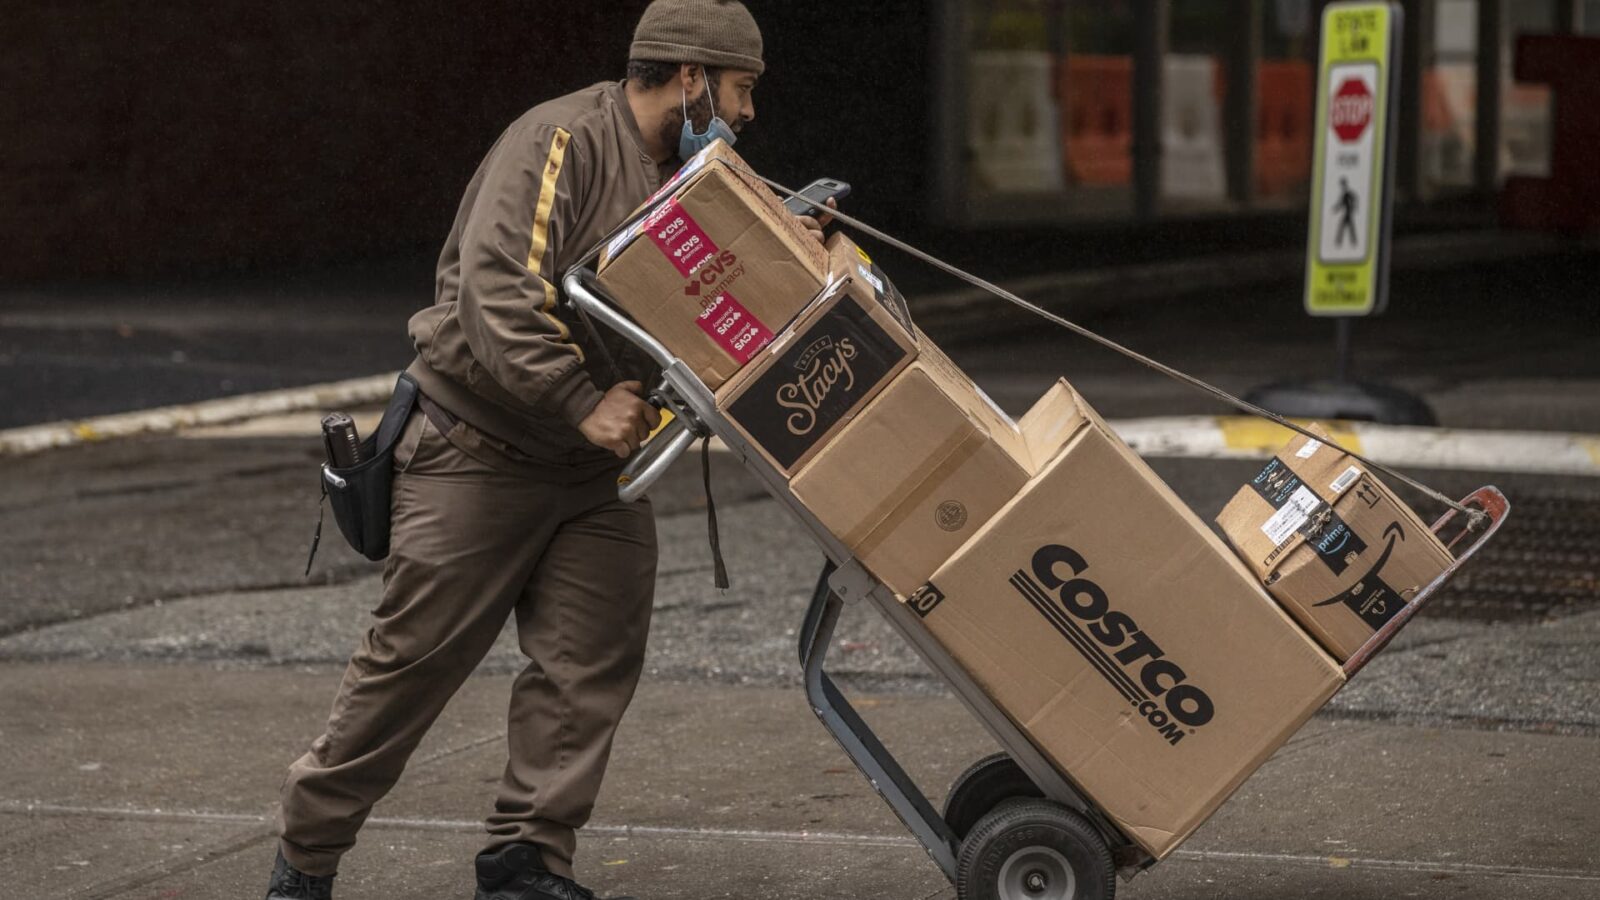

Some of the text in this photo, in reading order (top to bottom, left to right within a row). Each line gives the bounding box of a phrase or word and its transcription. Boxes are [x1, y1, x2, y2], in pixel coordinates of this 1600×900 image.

[1336, 12, 1376, 33] STATE
[1330, 95, 1373, 125] STOP
[665, 217, 684, 234] CVS
[665, 224, 688, 246] pharmacy
[681, 235, 700, 252] CVS
[681, 242, 704, 264] pharmacy
[700, 250, 737, 285] CVS
[700, 262, 745, 309] pharmacy
[700, 302, 717, 319] CVS
[712, 306, 734, 329] pharmacy
[717, 317, 734, 335] CVS
[729, 322, 751, 345] pharmacy
[734, 333, 752, 351] CVS
[776, 337, 855, 435] Stacy's
[1318, 524, 1345, 552] prime
[1031, 543, 1215, 727] COSTCO
[1131, 699, 1186, 746] .COM
